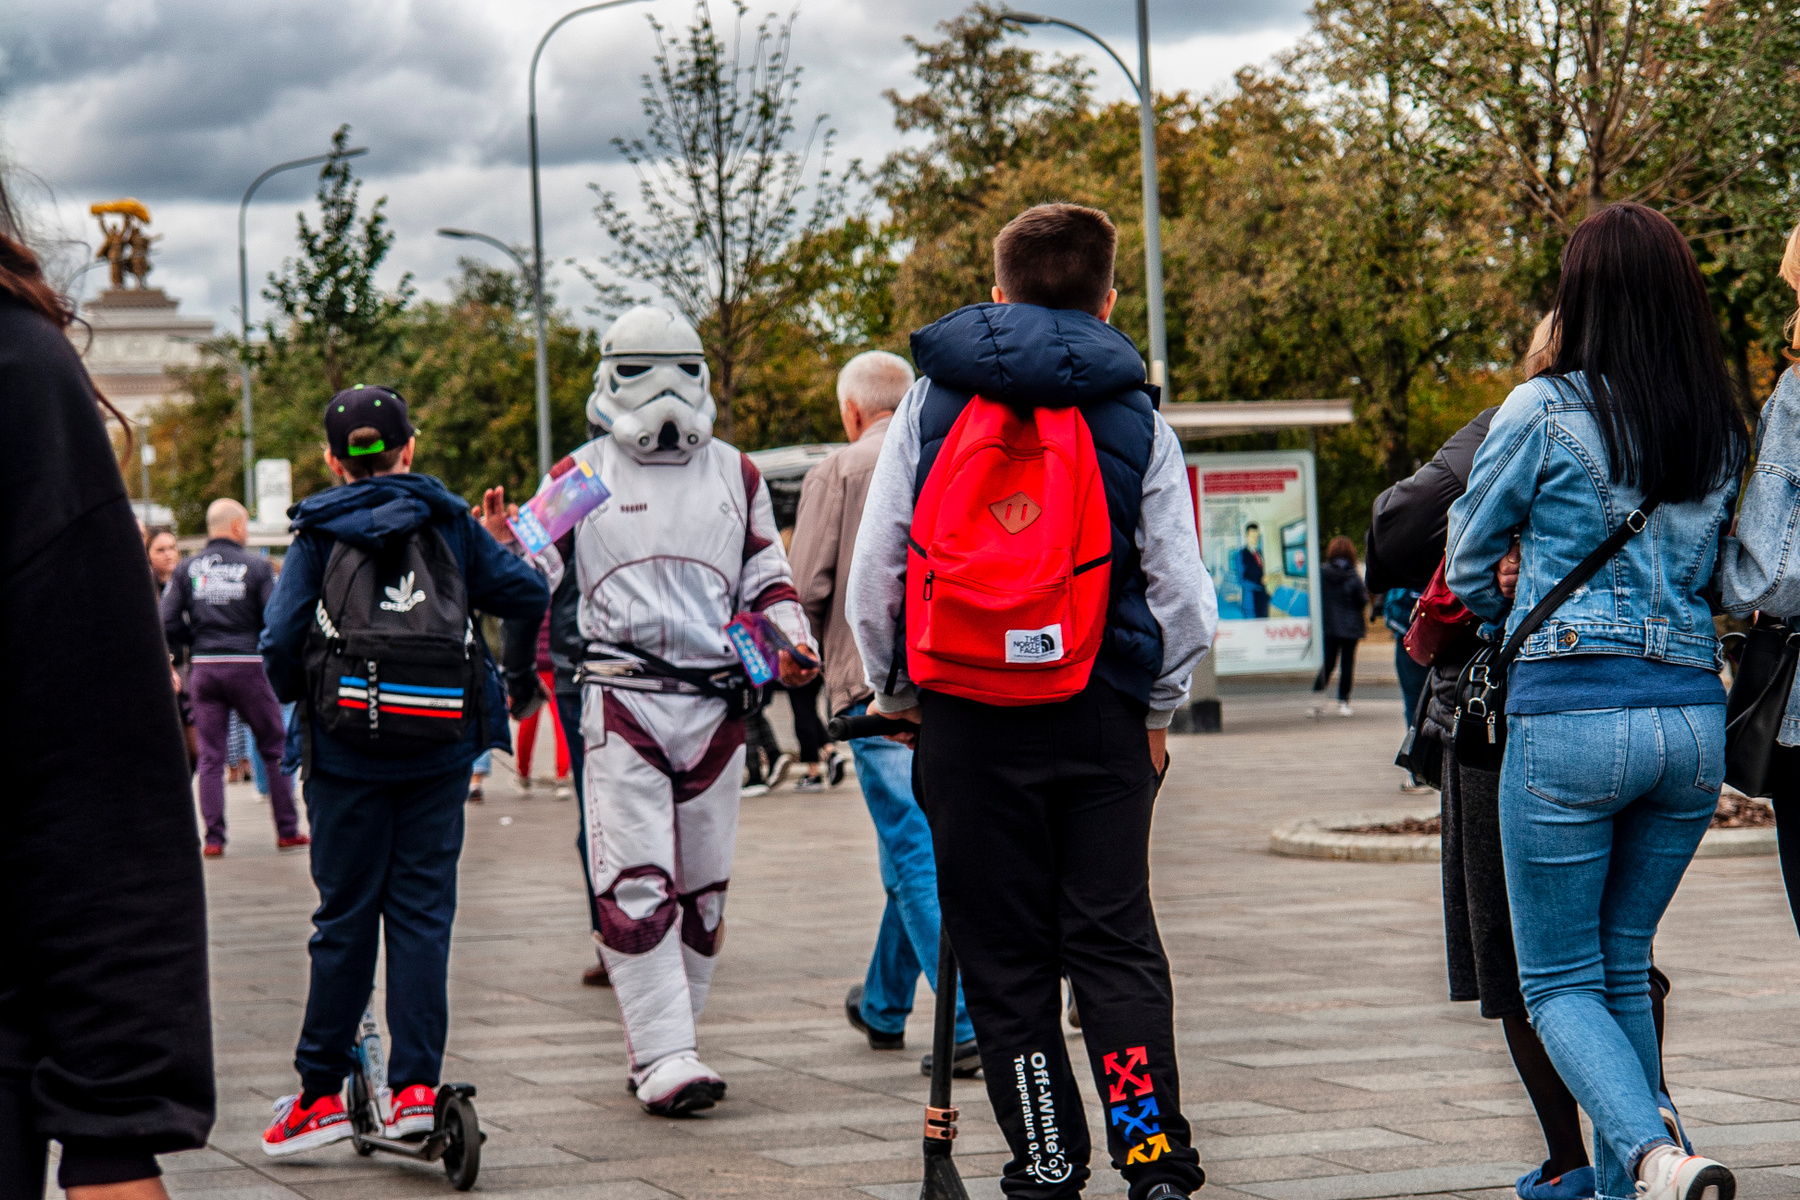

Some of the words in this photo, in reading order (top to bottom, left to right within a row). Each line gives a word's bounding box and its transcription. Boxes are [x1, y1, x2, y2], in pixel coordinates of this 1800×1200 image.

[1025, 634, 1040, 642] THE
[1013, 1054, 1036, 1141] Temperature
[1030, 1052, 1059, 1153] Off-White
